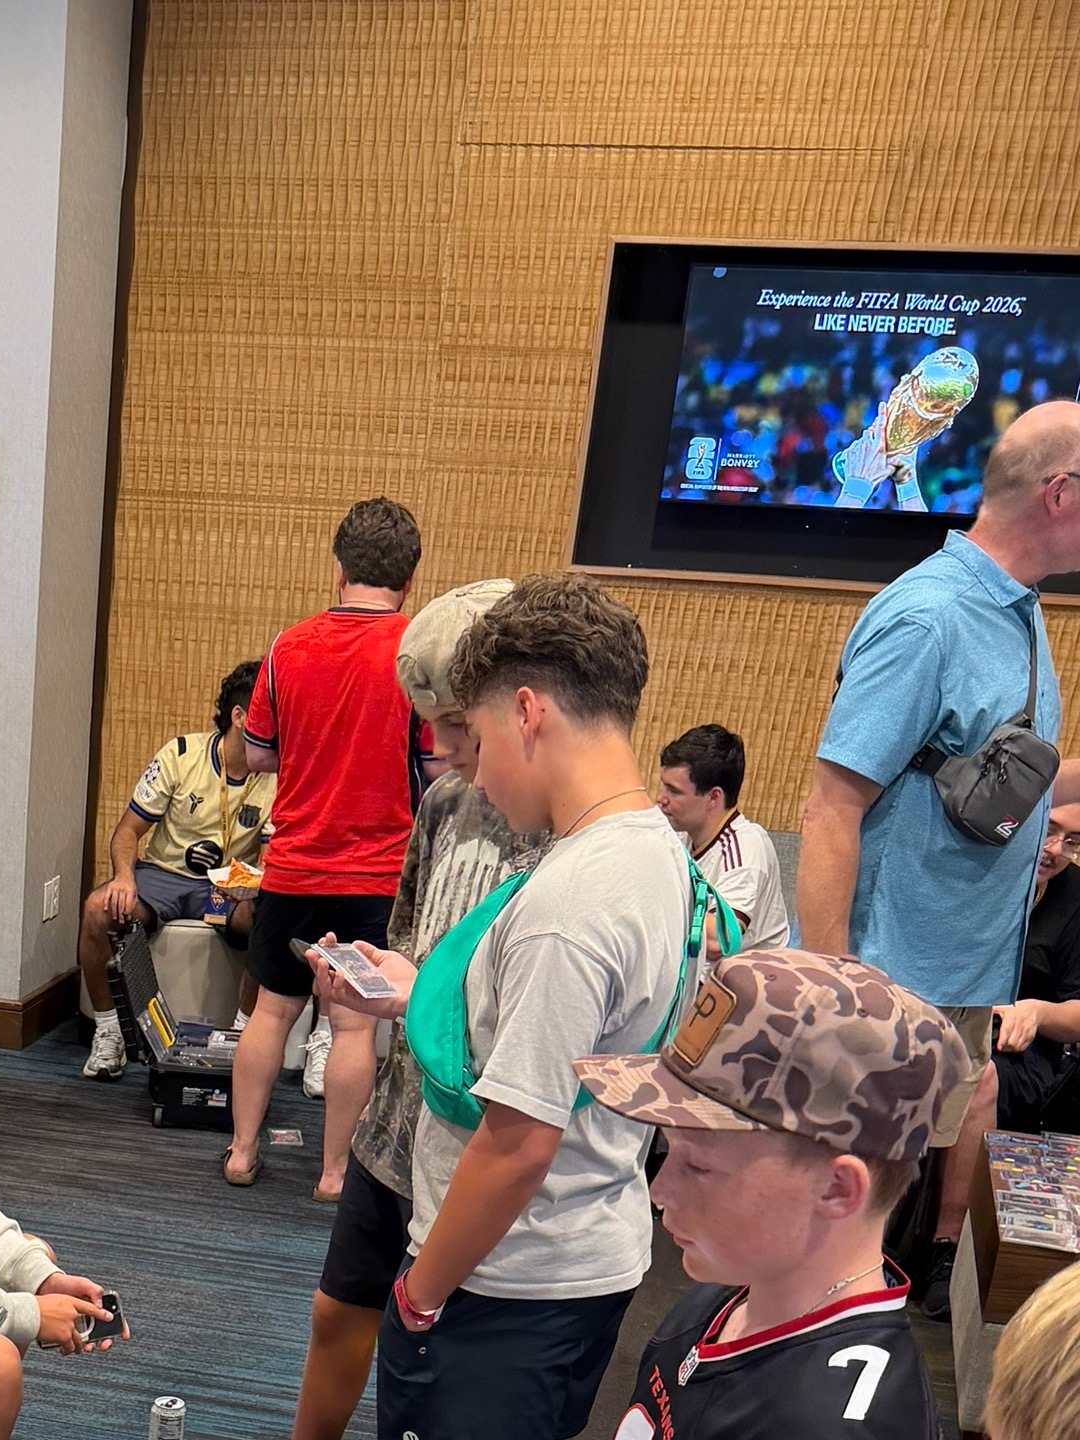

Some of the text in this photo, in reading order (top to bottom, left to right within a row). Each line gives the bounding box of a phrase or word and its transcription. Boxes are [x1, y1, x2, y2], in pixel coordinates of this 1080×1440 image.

[756, 288, 830, 310] Experience
[833, 290, 855, 309] the
[855, 292, 899, 310] FIFA
[904, 292, 946, 312] World
[948, 295, 980, 316] Cup
[813, 312, 957, 336] LIKE NEVER BEFORE.
[720, 458, 760, 468] BONVOY
[827, 1343, 891, 1421] 7
